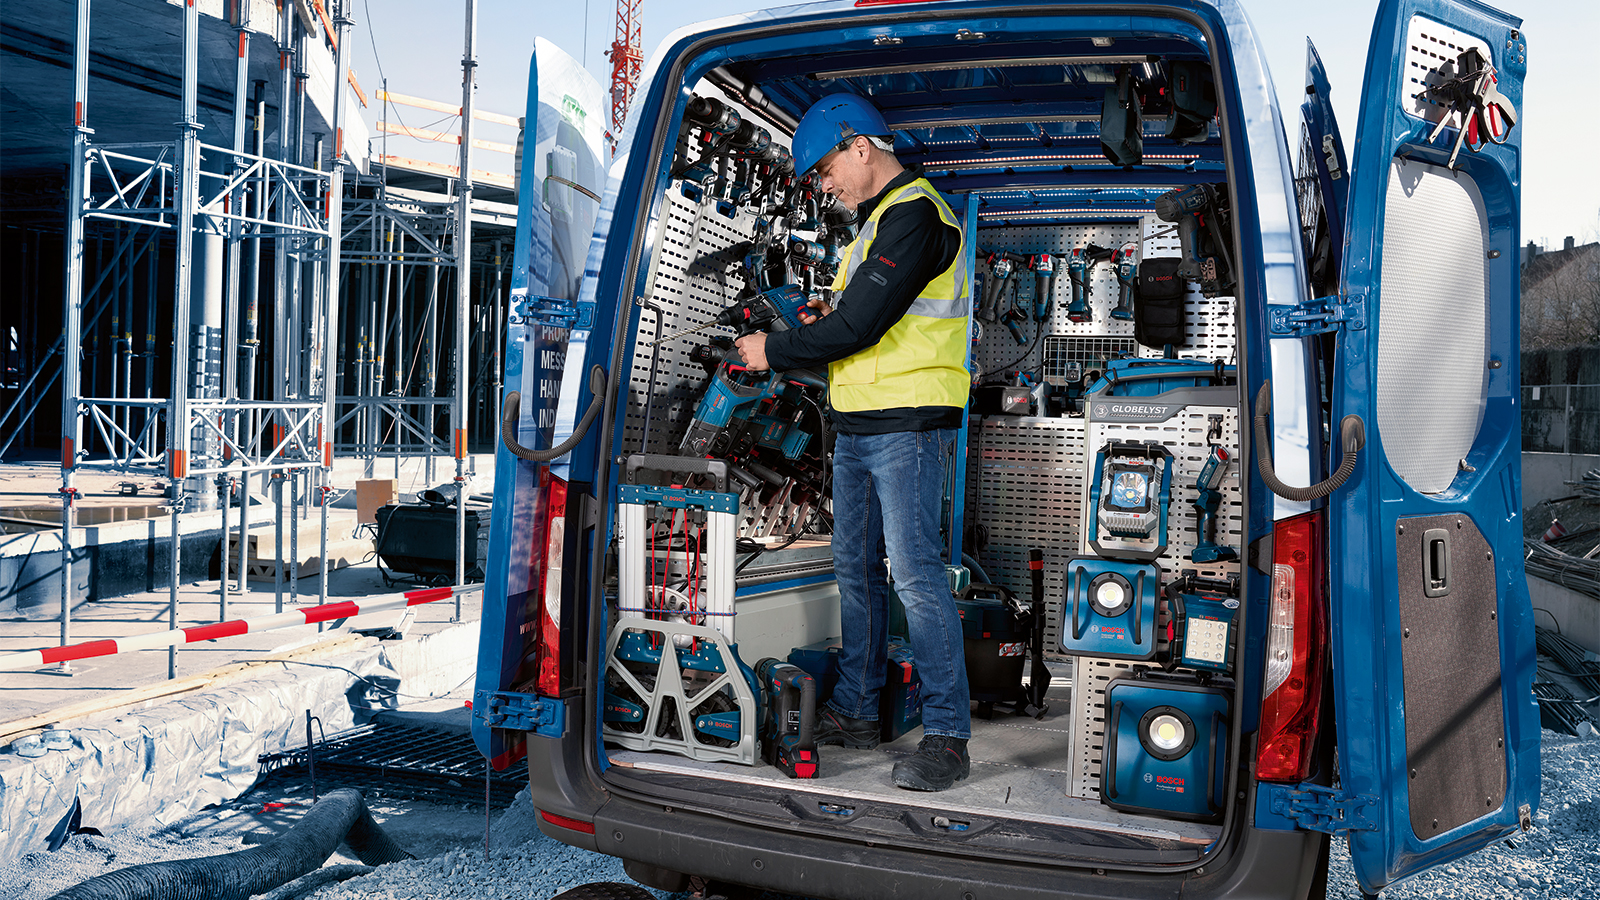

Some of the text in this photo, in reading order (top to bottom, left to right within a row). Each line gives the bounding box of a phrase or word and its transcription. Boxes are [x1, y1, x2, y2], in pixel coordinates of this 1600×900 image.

[879, 255, 897, 268] BOSCH
[541, 349, 565, 371] MESS
[539, 378, 560, 399] HAN
[1112, 404, 1169, 414] GLOBELYST
[538, 408, 556, 429] IND
[1101, 626, 1125, 634] BOSCH
[614, 706, 632, 714] BOSCH
[715, 721, 733, 729] BOSCH
[1156, 775, 1185, 786] BOSCH
